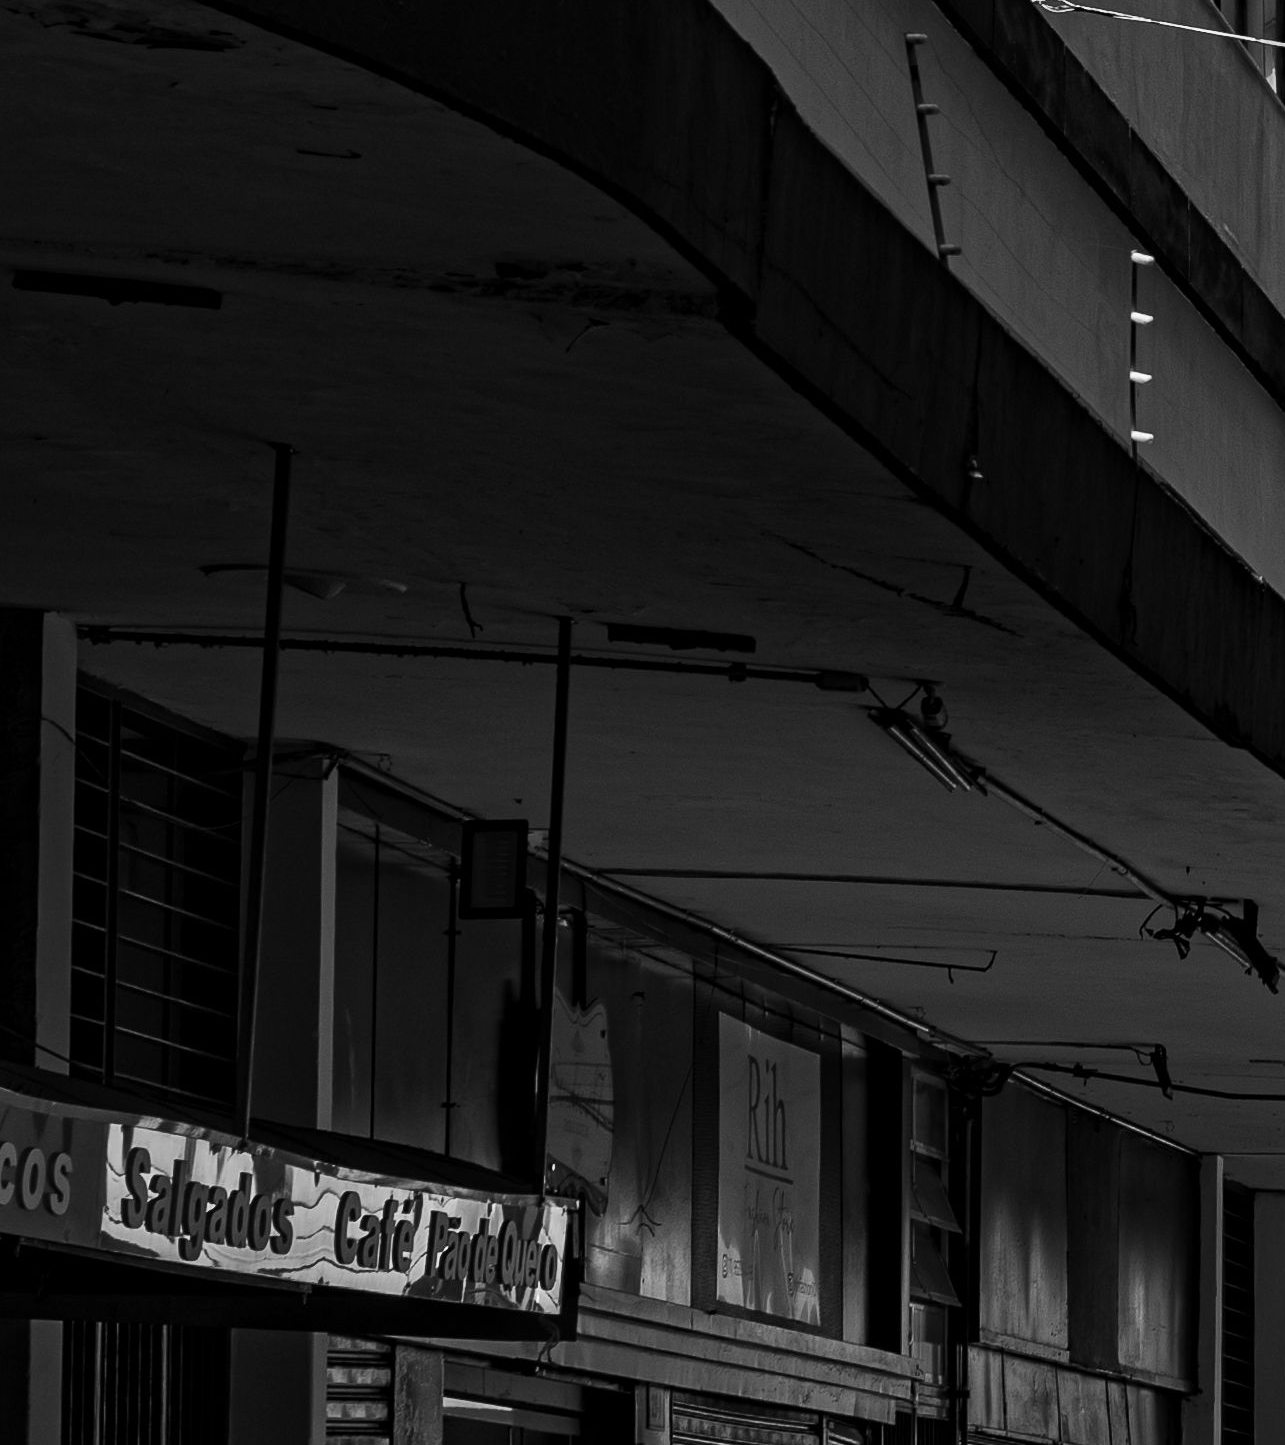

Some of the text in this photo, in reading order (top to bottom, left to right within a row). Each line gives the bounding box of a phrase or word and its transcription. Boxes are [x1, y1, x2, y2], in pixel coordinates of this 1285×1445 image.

[747, 1055, 788, 1171] Rih
[121, 1147, 295, 1261] Salgados
[334, 1191, 417, 1273] Café
[426, 1210, 471, 1281] Pão
[471, 1218, 499, 1285] de
